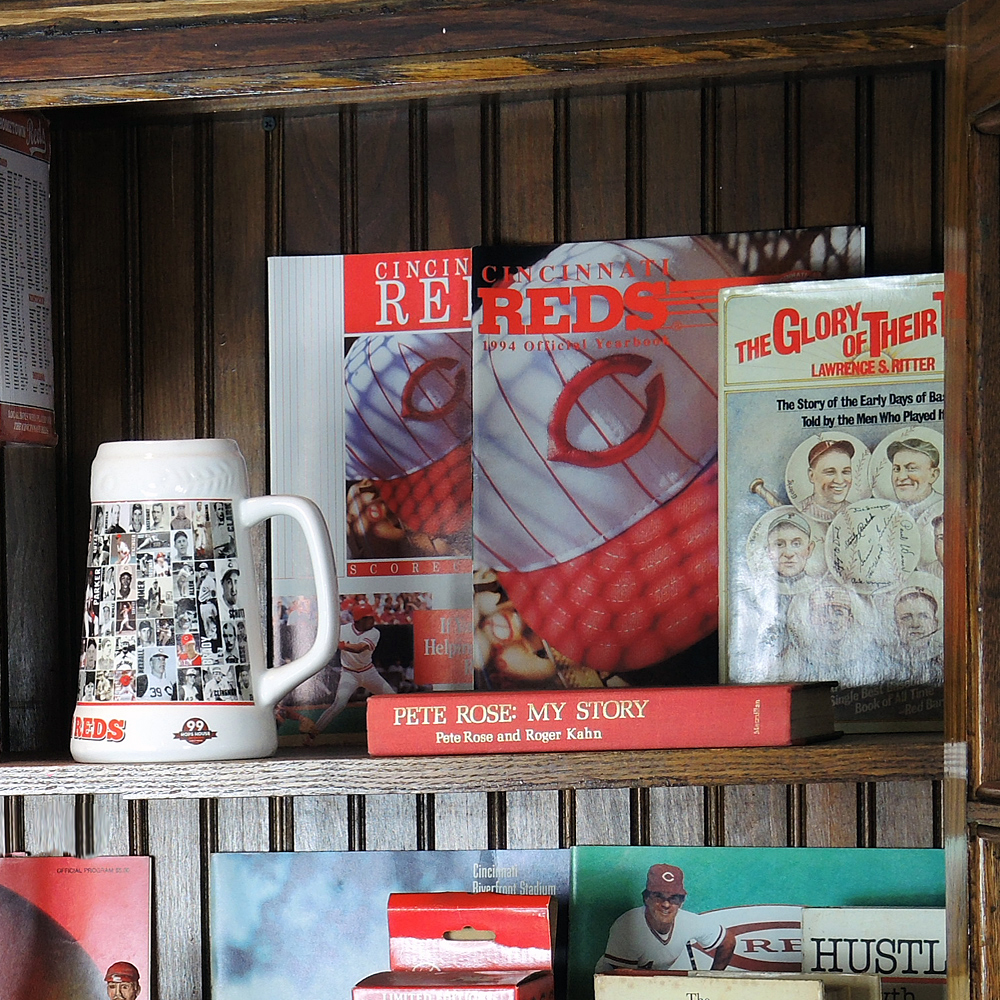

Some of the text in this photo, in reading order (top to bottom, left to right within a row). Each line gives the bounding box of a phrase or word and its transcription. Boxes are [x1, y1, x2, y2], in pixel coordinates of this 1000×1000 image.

[482, 257, 671, 284] CINCINNATI
[477, 280, 672, 335] REDS
[735, 301, 862, 364] THE GLORY
[842, 308, 938, 358] OF THEIR
[482, 335, 671, 353] 1994 Official Yearbook
[811, 356, 936, 378] LAWRENCE S. RITTER
[776, 391, 927, 413] The Story of the Early Days of
[801, 410, 936, 429] Told by the Men Who Played
[93, 567, 101, 606] PARKER
[150, 687, 162, 698] 39
[393, 699, 650, 726] PETE ROSE: MY STORY
[74, 716, 127, 742] REDS
[187, 720, 204, 732] 99
[436, 727, 603, 745] Pete Rose and Roger Kahn
[472, 863, 518, 878] Cincinnati
[472, 880, 557, 895] Riverfront Stadium
